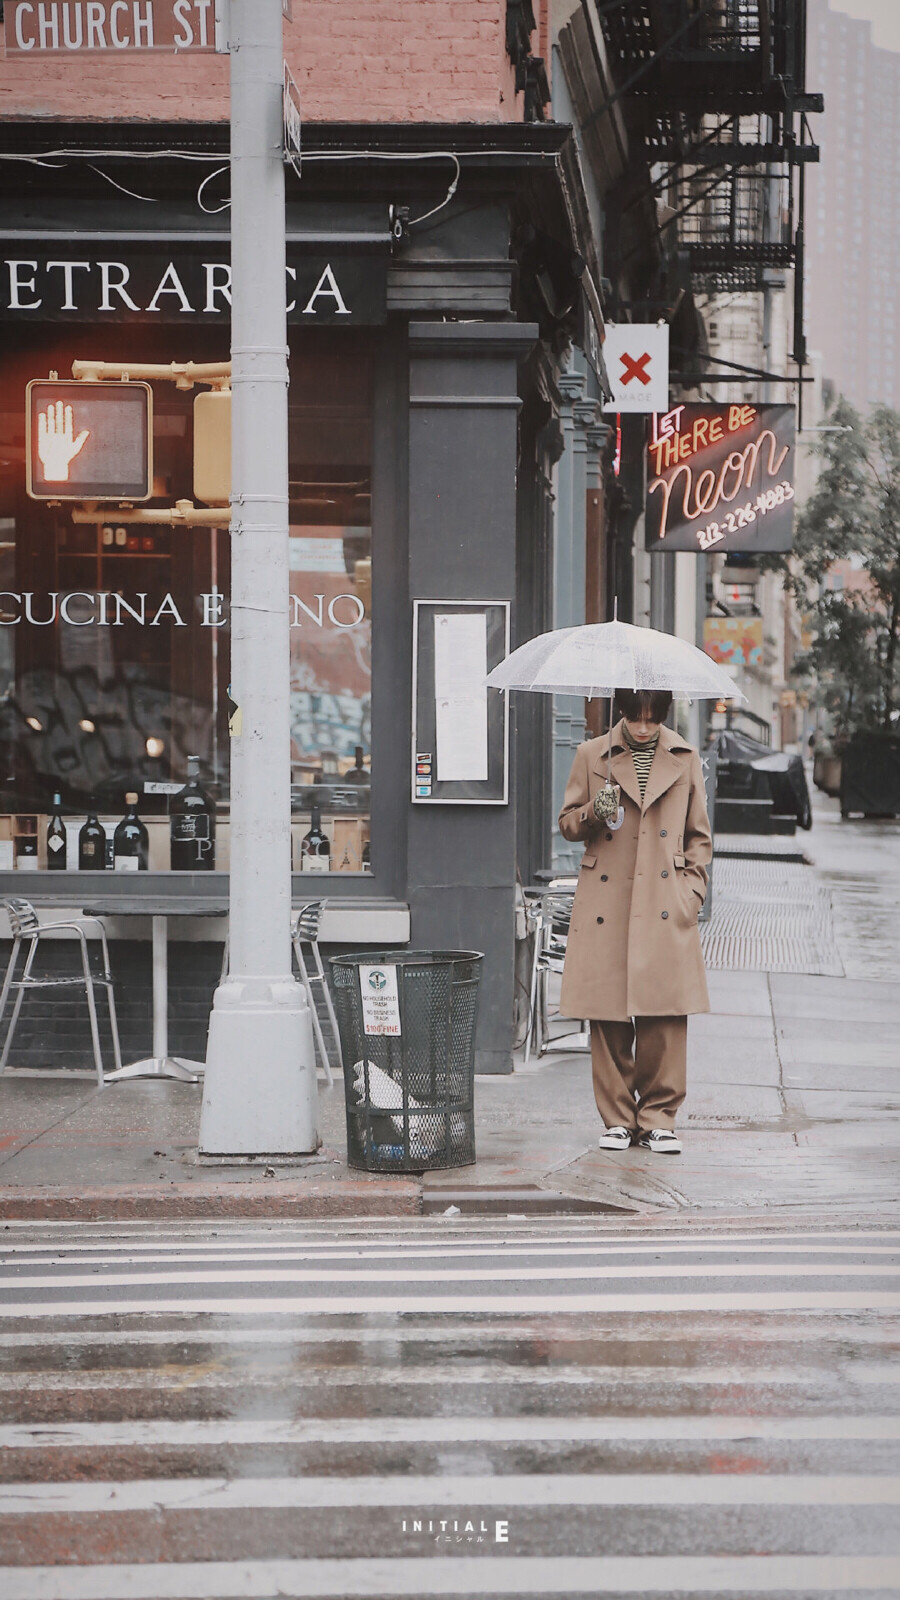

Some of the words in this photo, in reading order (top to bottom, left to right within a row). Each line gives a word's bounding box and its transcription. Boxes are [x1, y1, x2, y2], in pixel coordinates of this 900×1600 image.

[15, 1, 155, 50] CHURCH
[173, 0, 211, 48] ST
[4, 259, 353, 315] ETRARA
[649, 417, 725, 476] THERE
[727, 404, 757, 432] BE
[652, 404, 686, 445] LET
[0, 592, 187, 627] CUCINA
[200, 593, 227, 627] E
